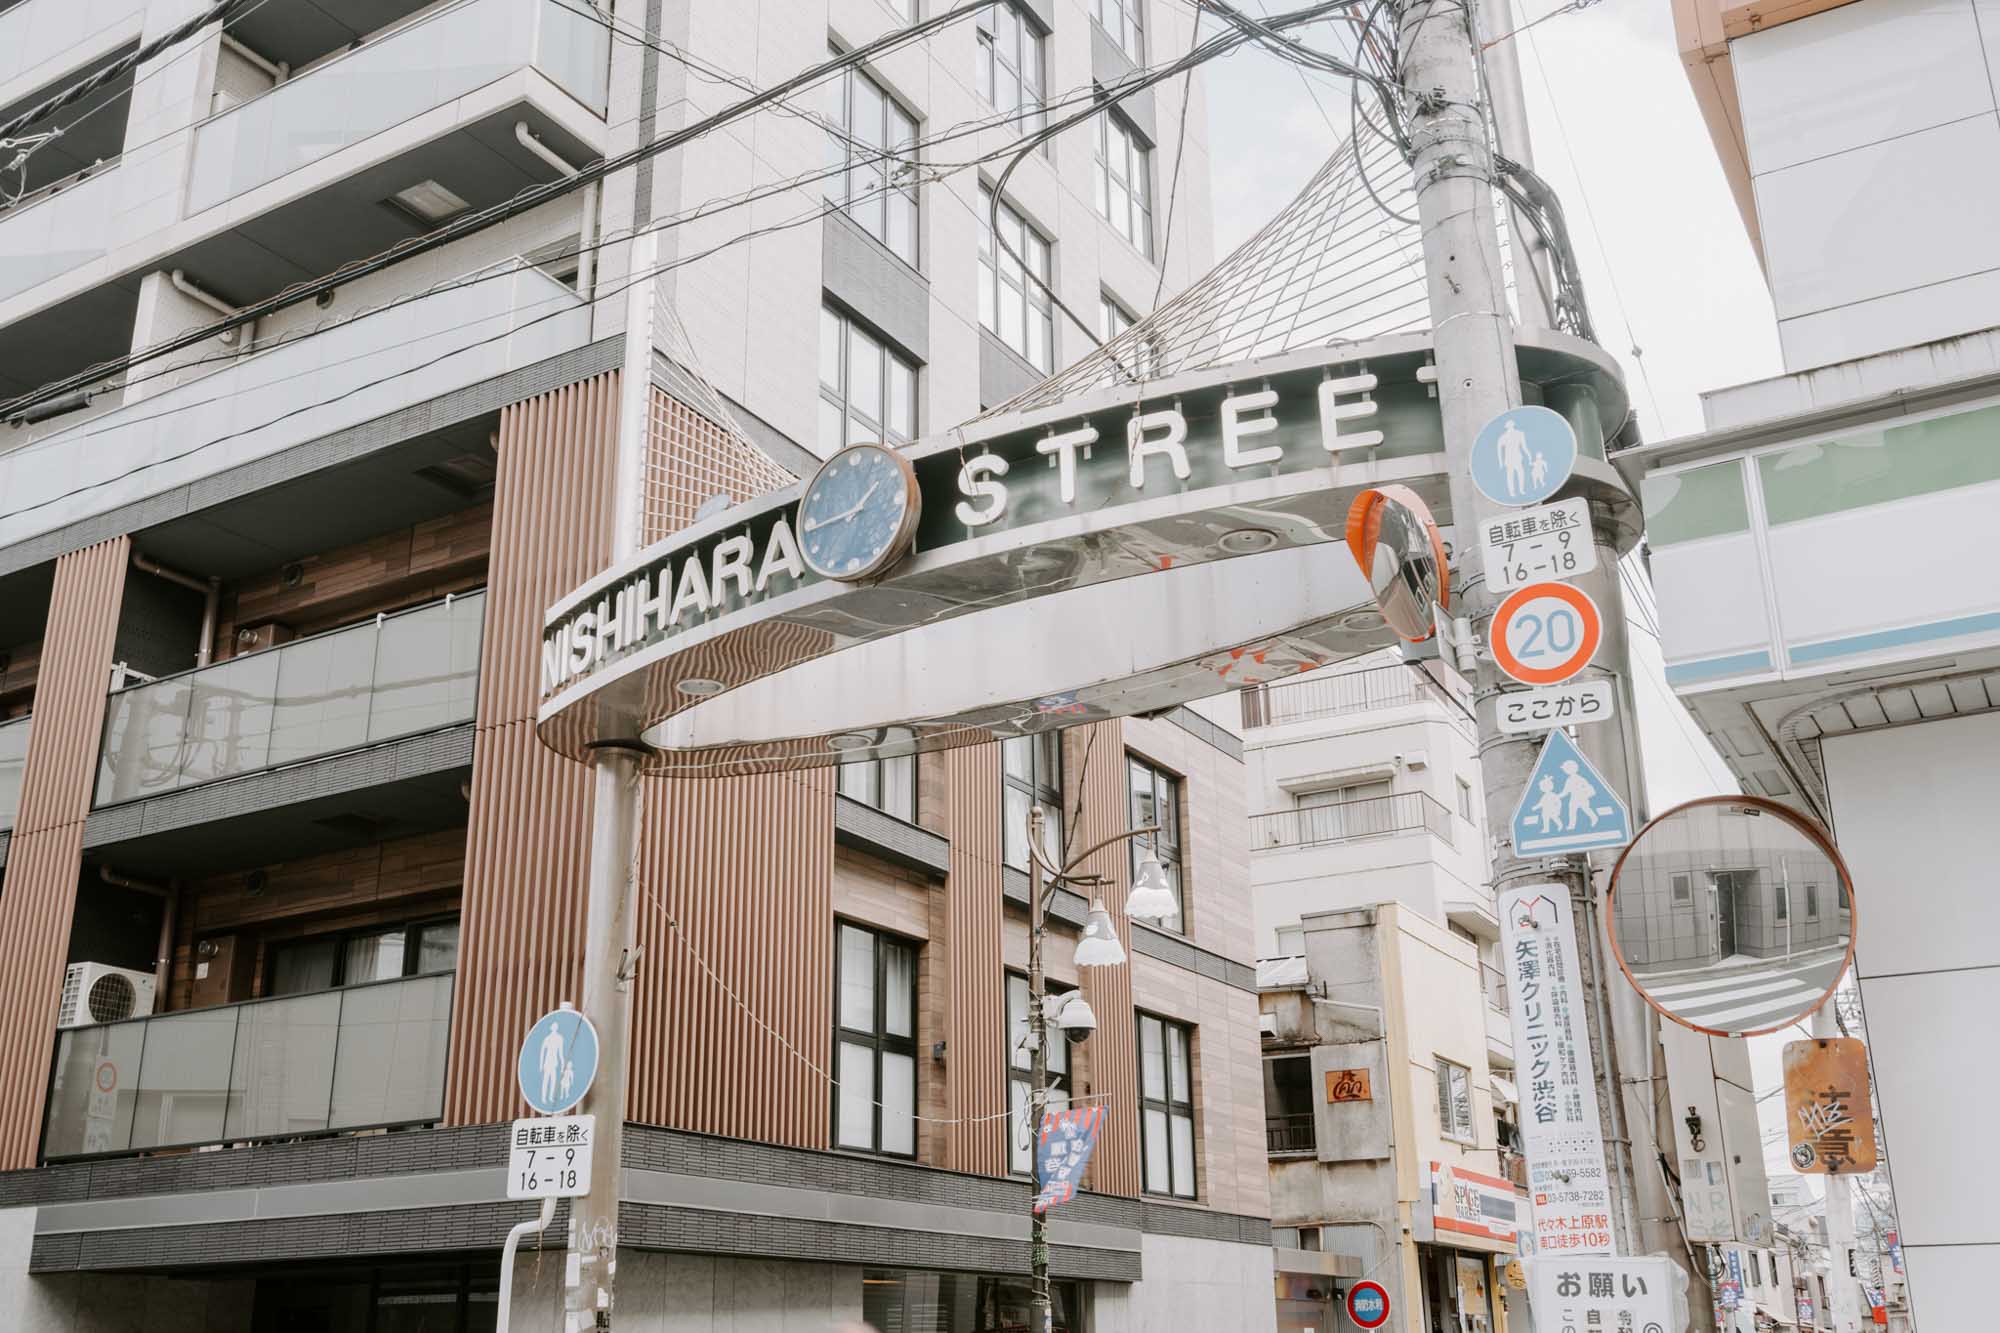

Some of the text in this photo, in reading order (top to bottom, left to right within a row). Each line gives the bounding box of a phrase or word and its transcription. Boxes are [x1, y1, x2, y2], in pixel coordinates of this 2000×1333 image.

[541, 366, 1437, 697] NISHIHARA STREE
[1489, 510, 1581, 544] 自転車を除く
[1503, 552, 1577, 584] 16-18
[1515, 610, 1575, 660] 20
[1508, 693, 1600, 723] ここから
[1516, 939, 1557, 1123] 矢澤クリニック渋谷
[516, 1125, 589, 1146] 自転車を除く
[521, 1170, 577, 1191] 16-18
[1556, 1272, 1648, 1298] お願い
[1587, 1309, 1603, 1333] 自
